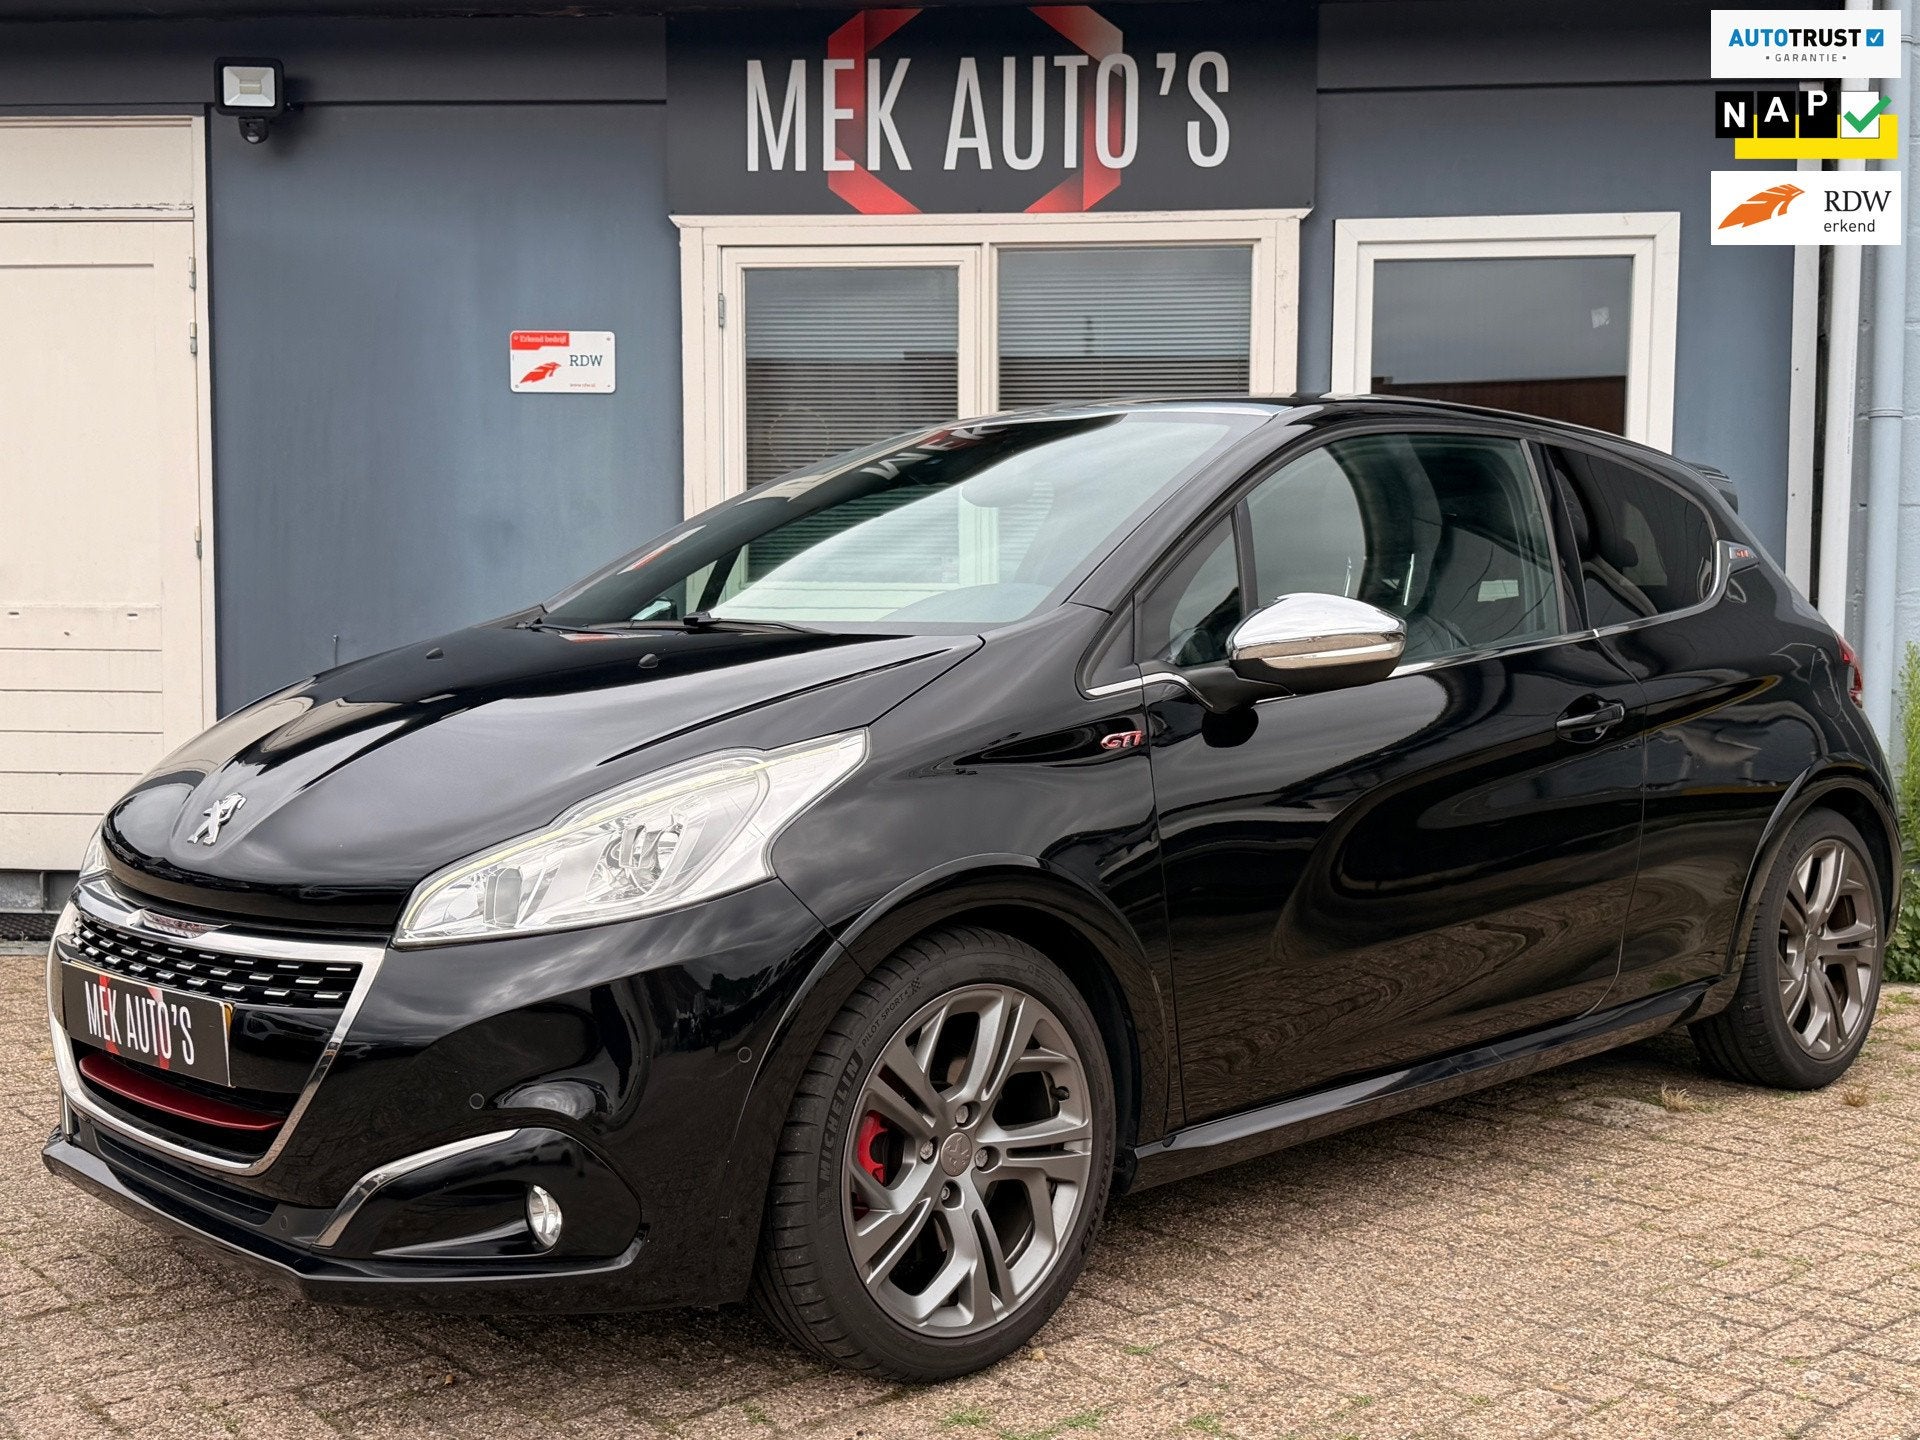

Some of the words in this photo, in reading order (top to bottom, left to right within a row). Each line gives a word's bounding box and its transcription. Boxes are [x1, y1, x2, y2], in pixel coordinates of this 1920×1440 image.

[747, 58, 912, 171] MEK
[943, 51, 1231, 170] AUTO'S
[569, 354, 603, 367] RDW
[84, 981, 122, 1045] MEK
[126, 993, 195, 1066] AUTO'S
[819, 1055, 860, 1183] MICHELIN
